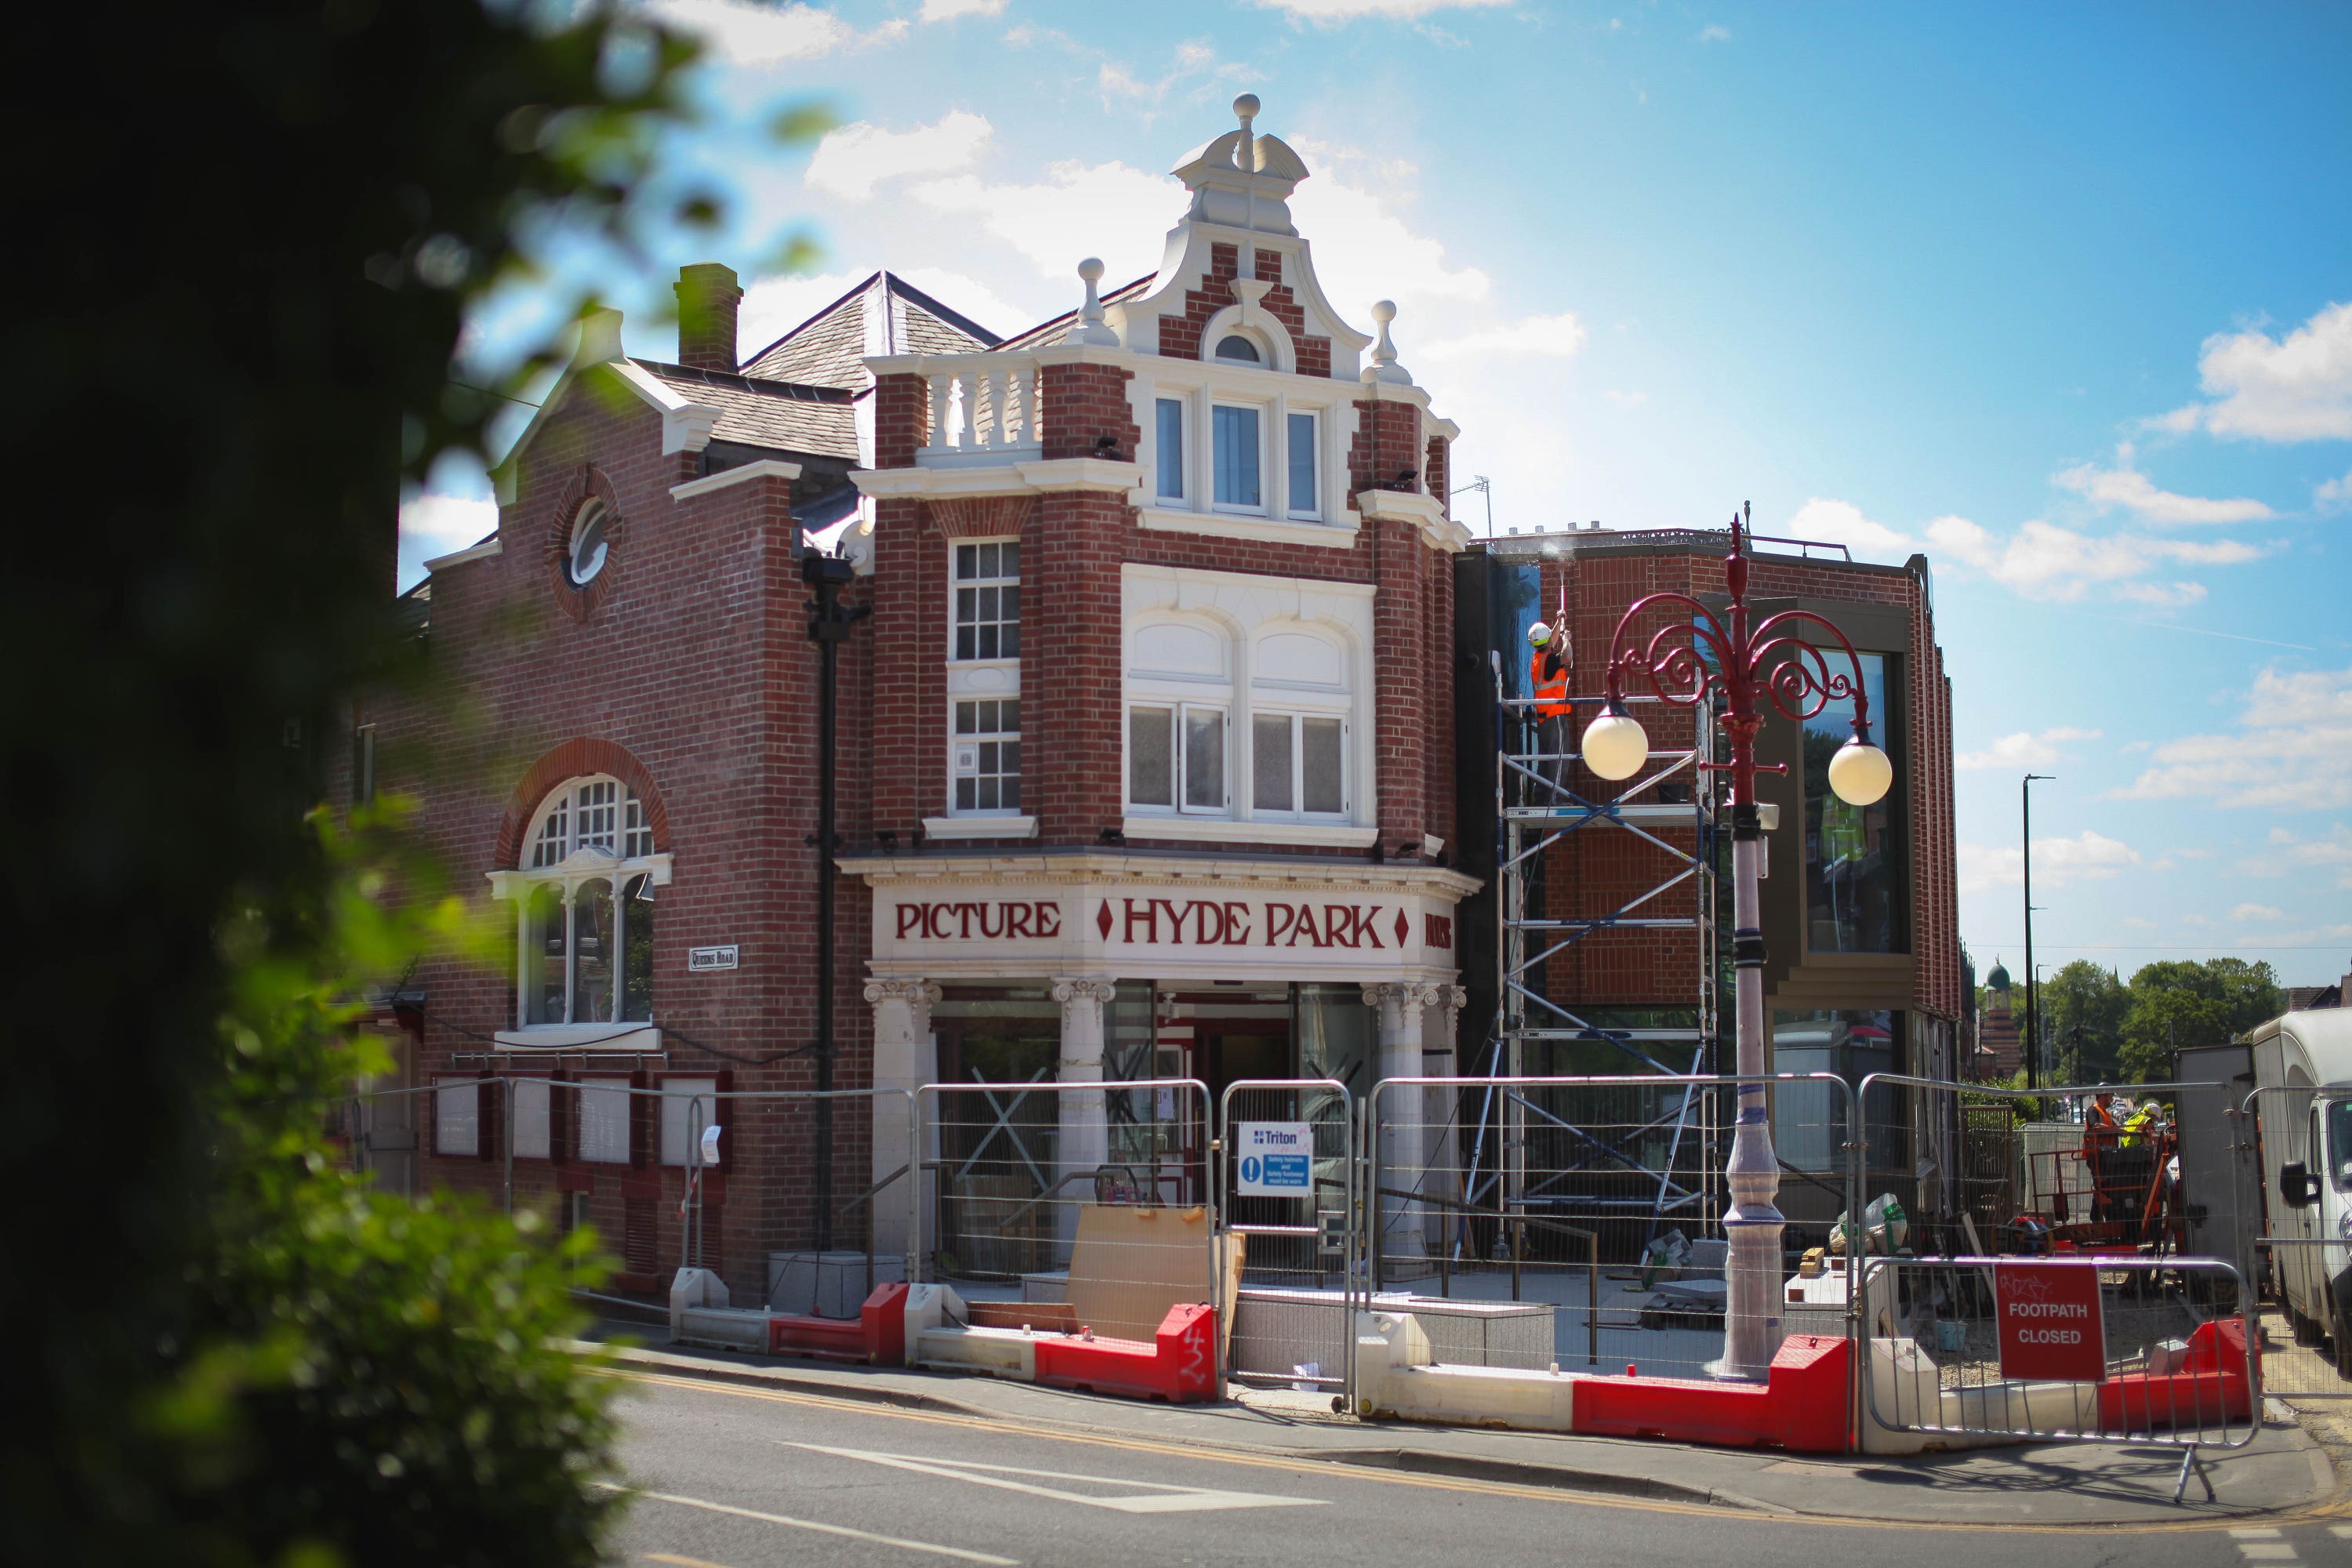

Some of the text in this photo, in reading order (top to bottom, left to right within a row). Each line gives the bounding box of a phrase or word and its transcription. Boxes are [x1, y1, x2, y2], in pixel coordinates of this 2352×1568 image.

[895, 902, 1062, 939] PICTURE
[1122, 898, 1386, 949] HYDE PARK
[717, 951, 734, 964] ROAD
[1265, 1131, 1297, 1144] Triton
[2009, 1303, 2088, 1318] FOOTPATH
[2019, 1330, 2082, 1345] CLOSED
